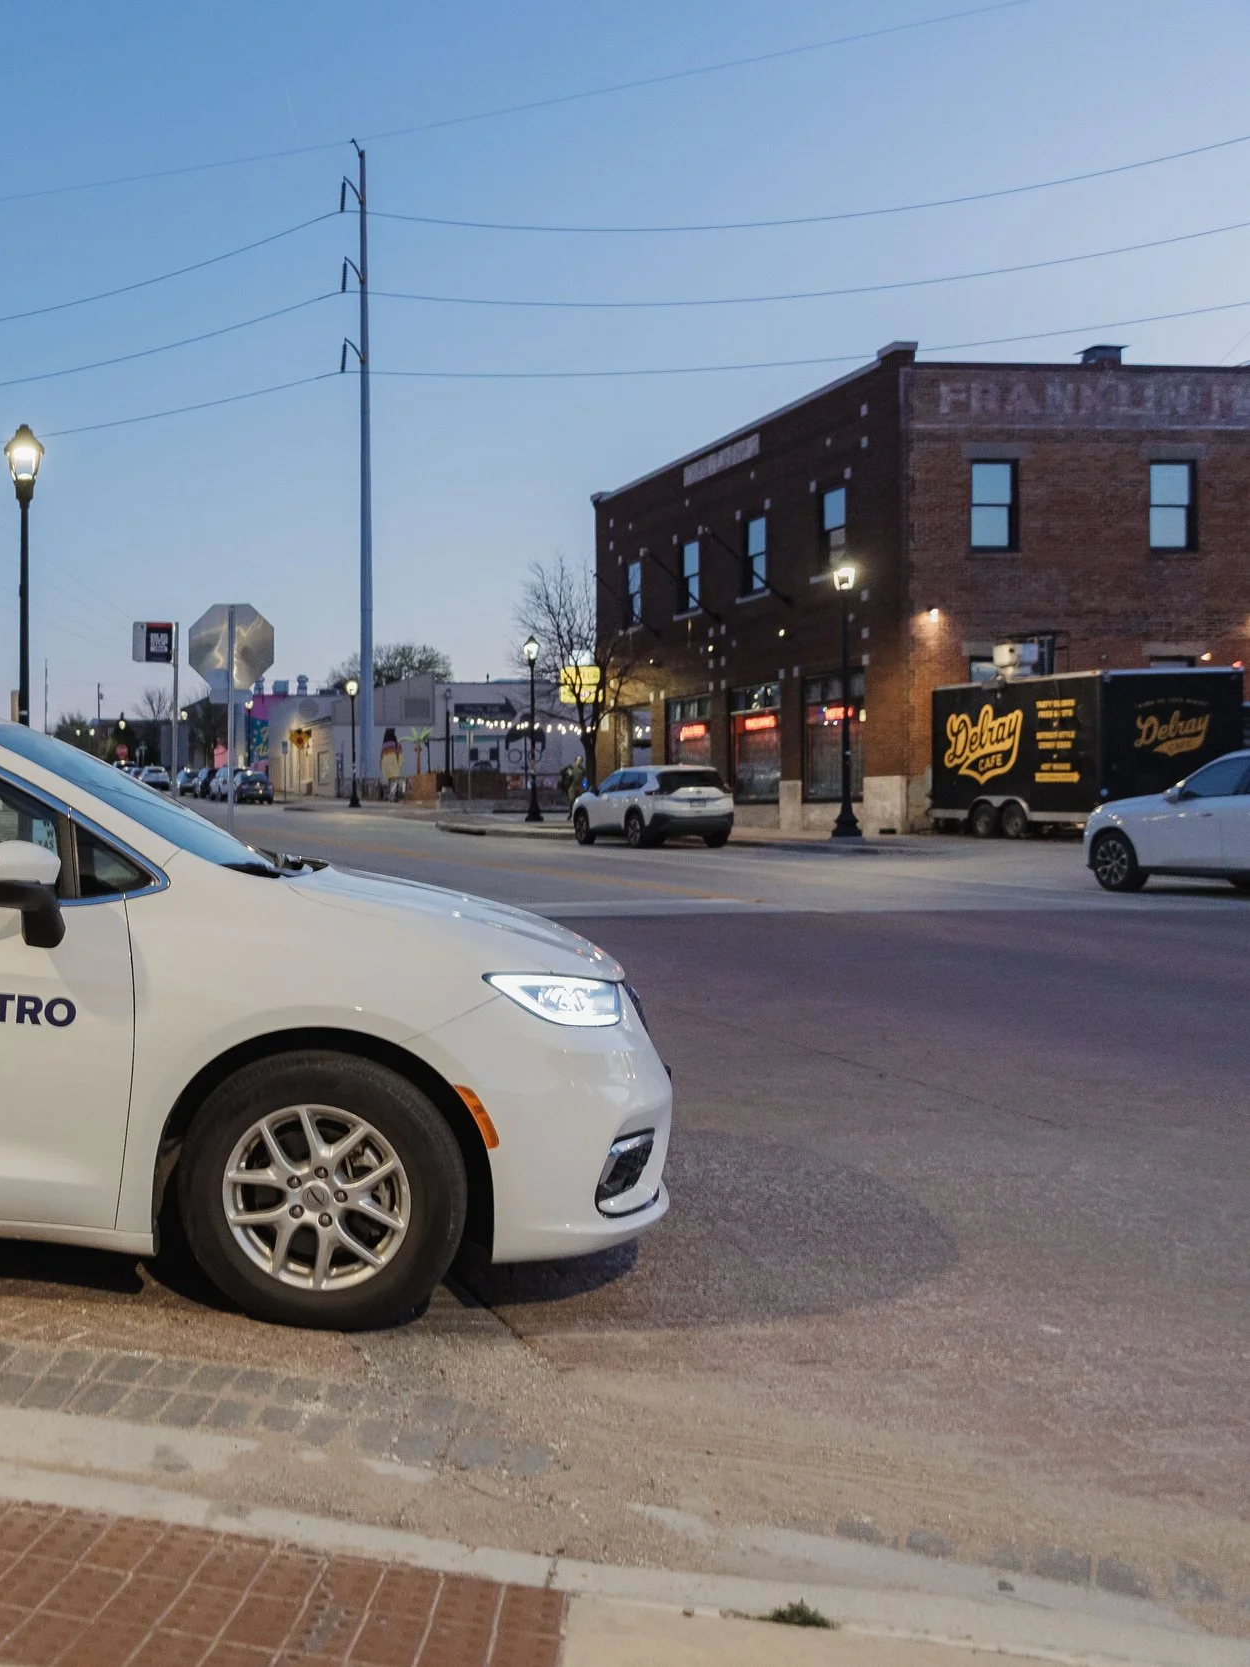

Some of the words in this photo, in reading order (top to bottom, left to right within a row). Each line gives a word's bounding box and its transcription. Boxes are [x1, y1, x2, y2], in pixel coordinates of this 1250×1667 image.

[946, 705, 1022, 767] Delray
[1134, 709, 1210, 748] Delray
[978, 753, 1003, 772] CAFE
